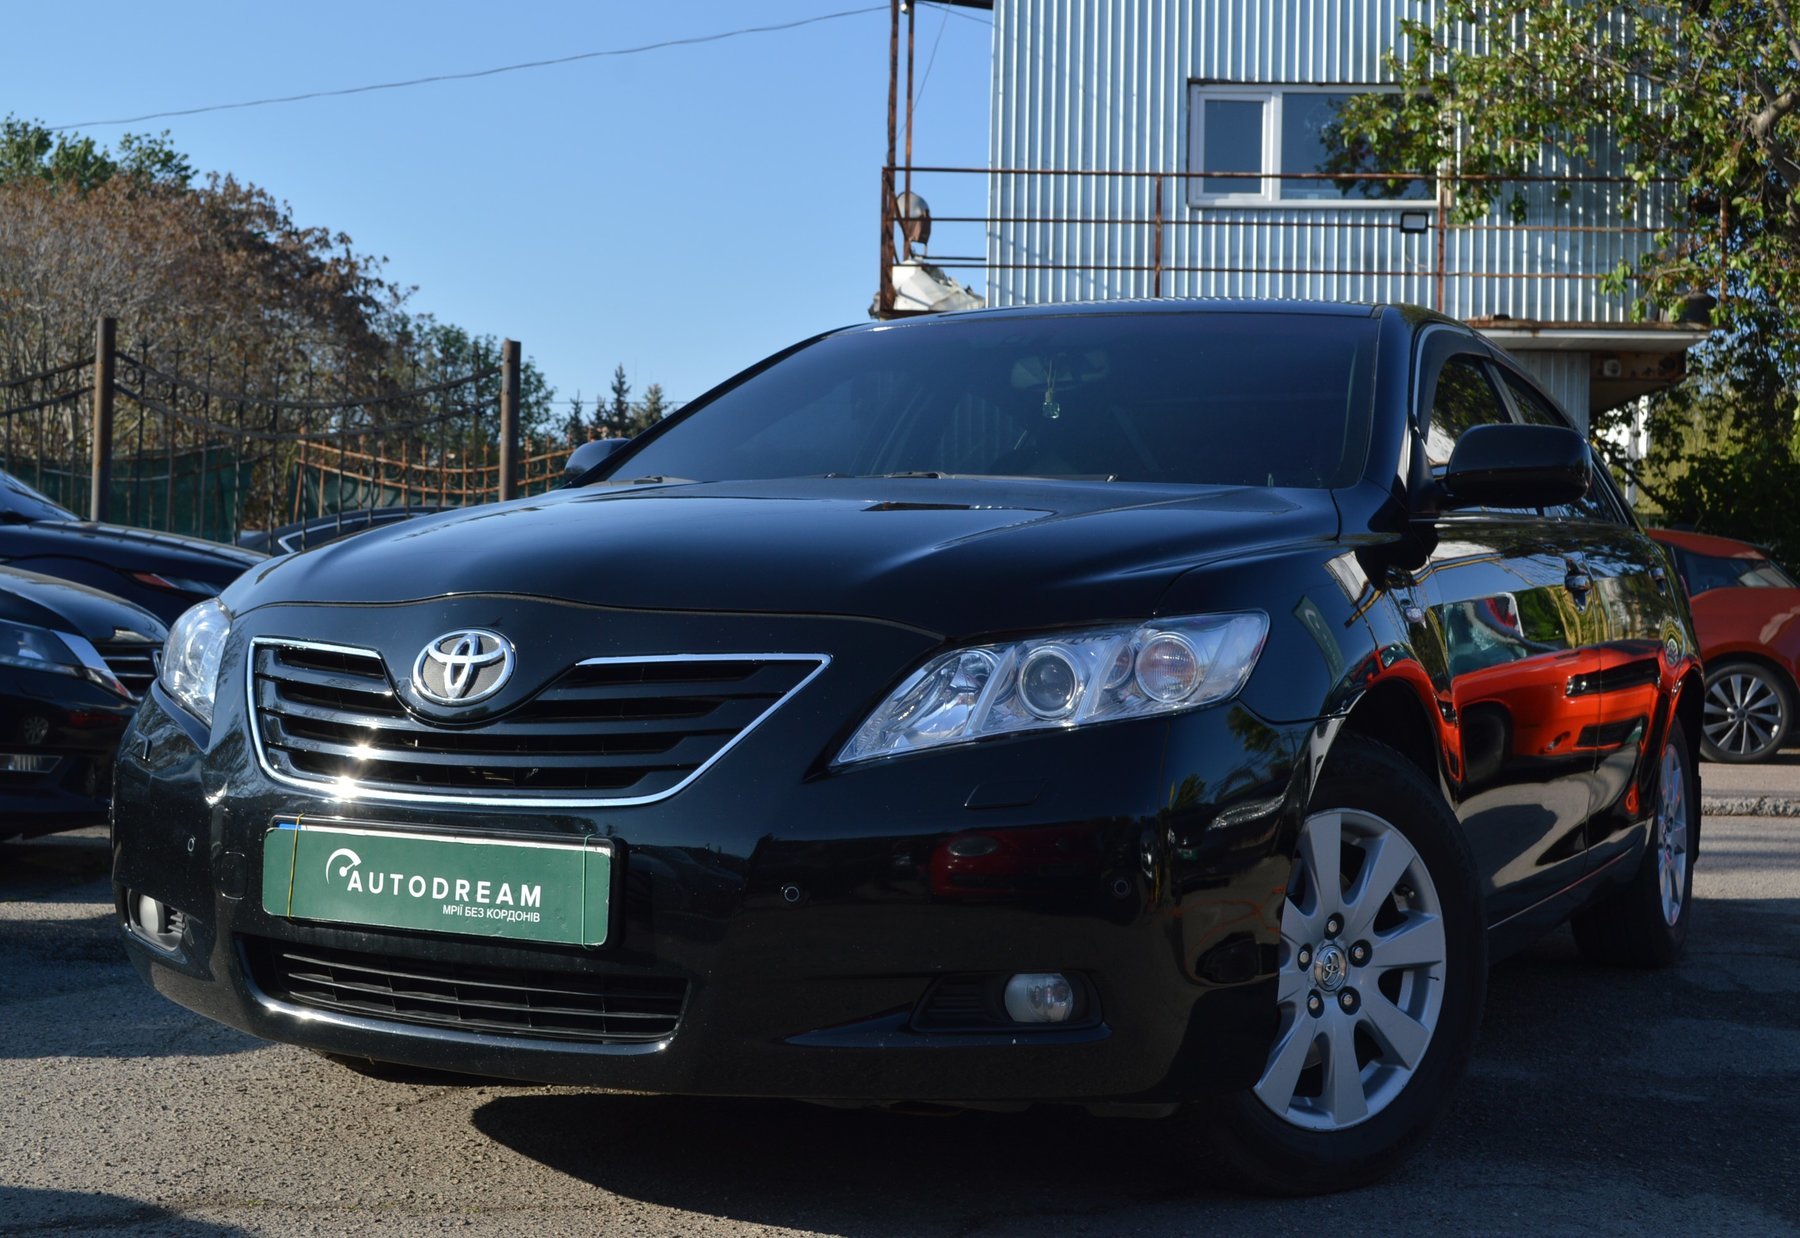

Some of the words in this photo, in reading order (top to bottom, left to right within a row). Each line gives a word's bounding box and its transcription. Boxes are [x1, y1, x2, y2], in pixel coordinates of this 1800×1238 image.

[347, 870, 541, 907] AUTODREAM
[442, 904, 463, 916] МРІЇ
[465, 906, 485, 918] БЕЗ
[486, 908, 541, 923] КОРДОНІВ
